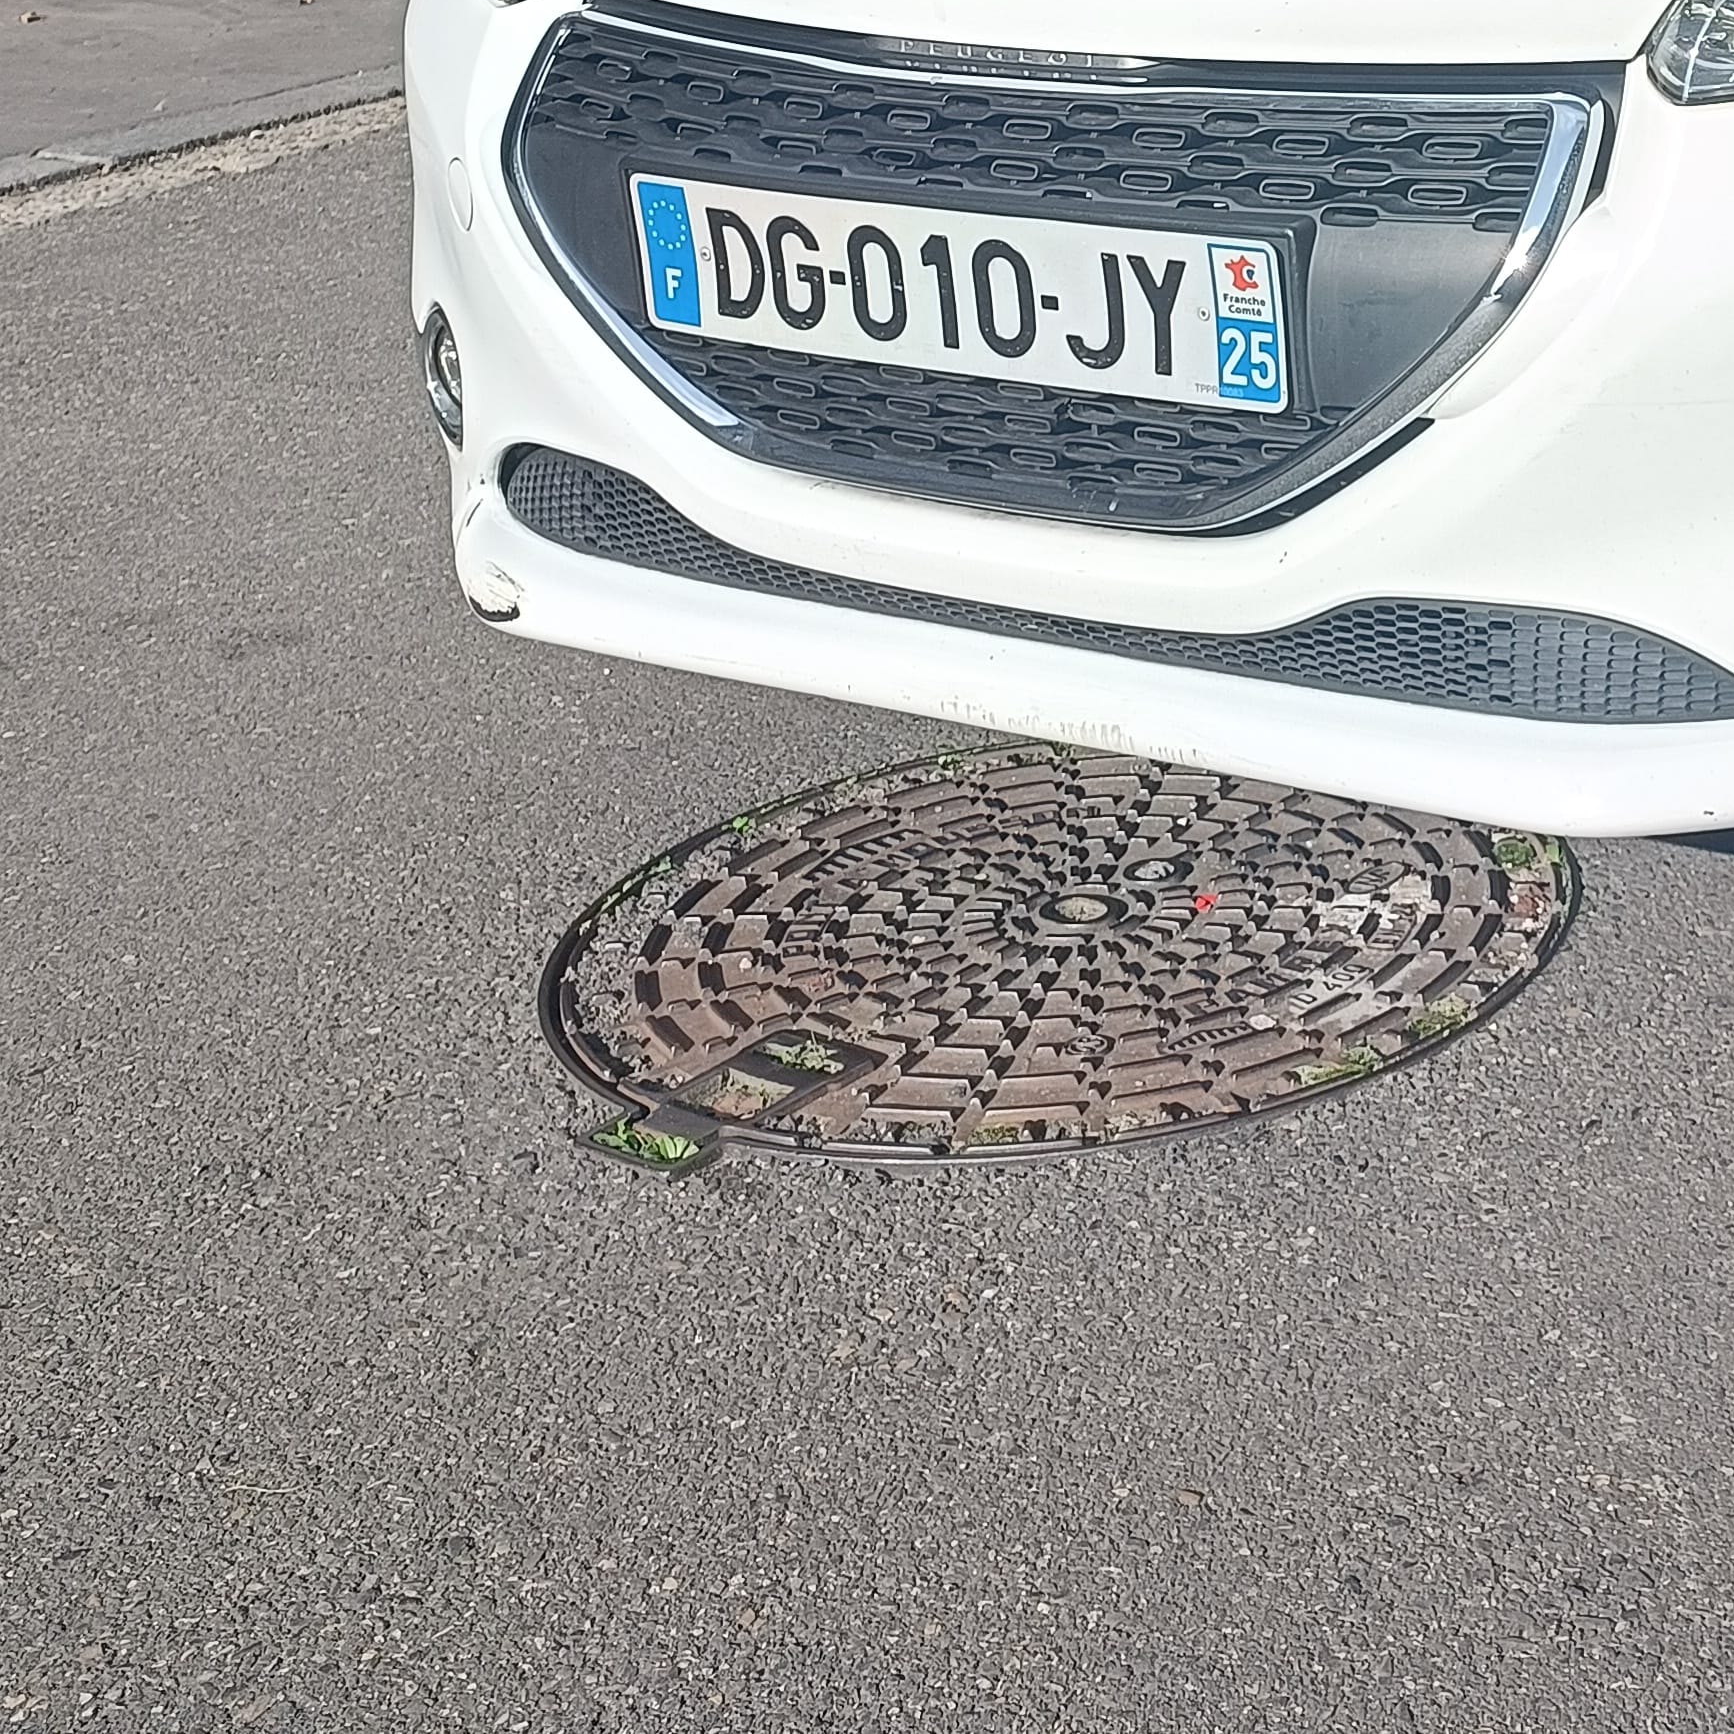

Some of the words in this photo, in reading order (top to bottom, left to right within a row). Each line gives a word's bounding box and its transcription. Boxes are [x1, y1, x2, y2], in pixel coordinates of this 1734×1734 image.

[665, 267, 682, 299] F
[705, 207, 1187, 376] DG-010-JY
[1223, 293, 1266, 307] Franche
[1221, 327, 1277, 390] 25
